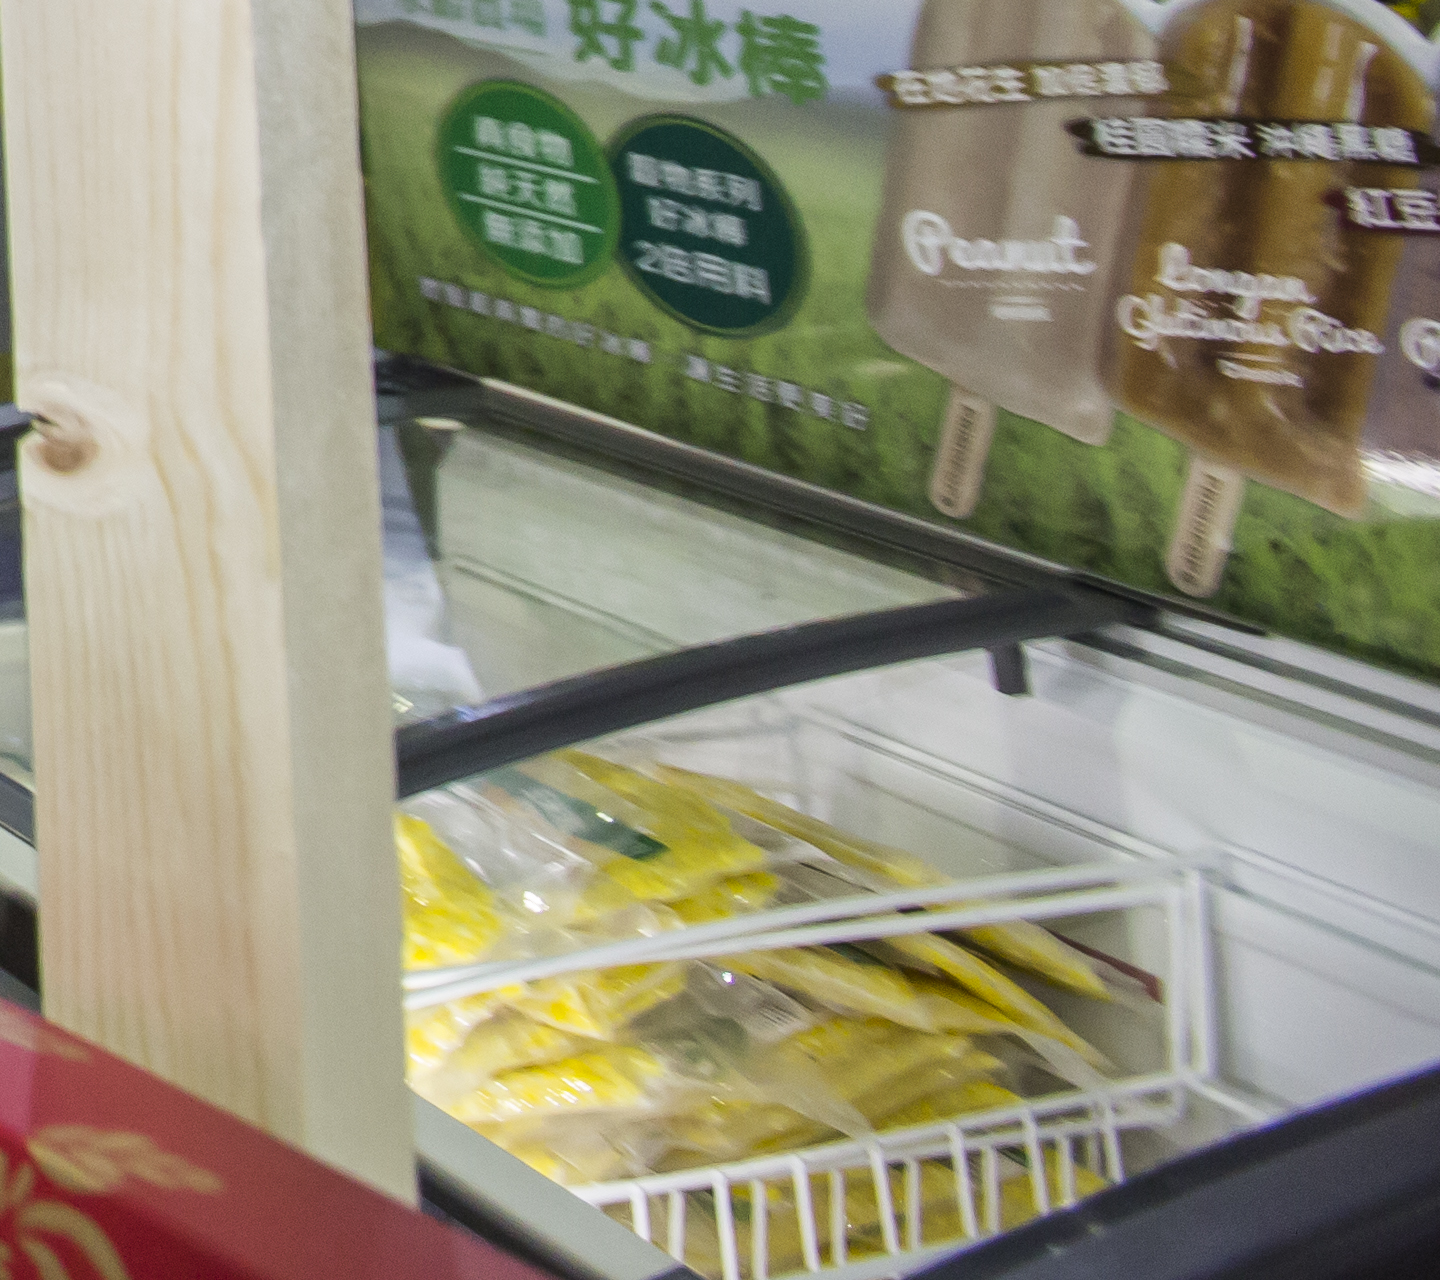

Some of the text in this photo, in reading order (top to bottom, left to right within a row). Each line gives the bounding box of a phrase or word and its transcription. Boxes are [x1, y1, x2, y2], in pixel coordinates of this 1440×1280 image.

[902, 209, 1098, 277] Peanut
[1153, 243, 1319, 321] Longan
[1116, 293, 1292, 369] Glutinous
[1288, 306, 1386, 354] Rice
